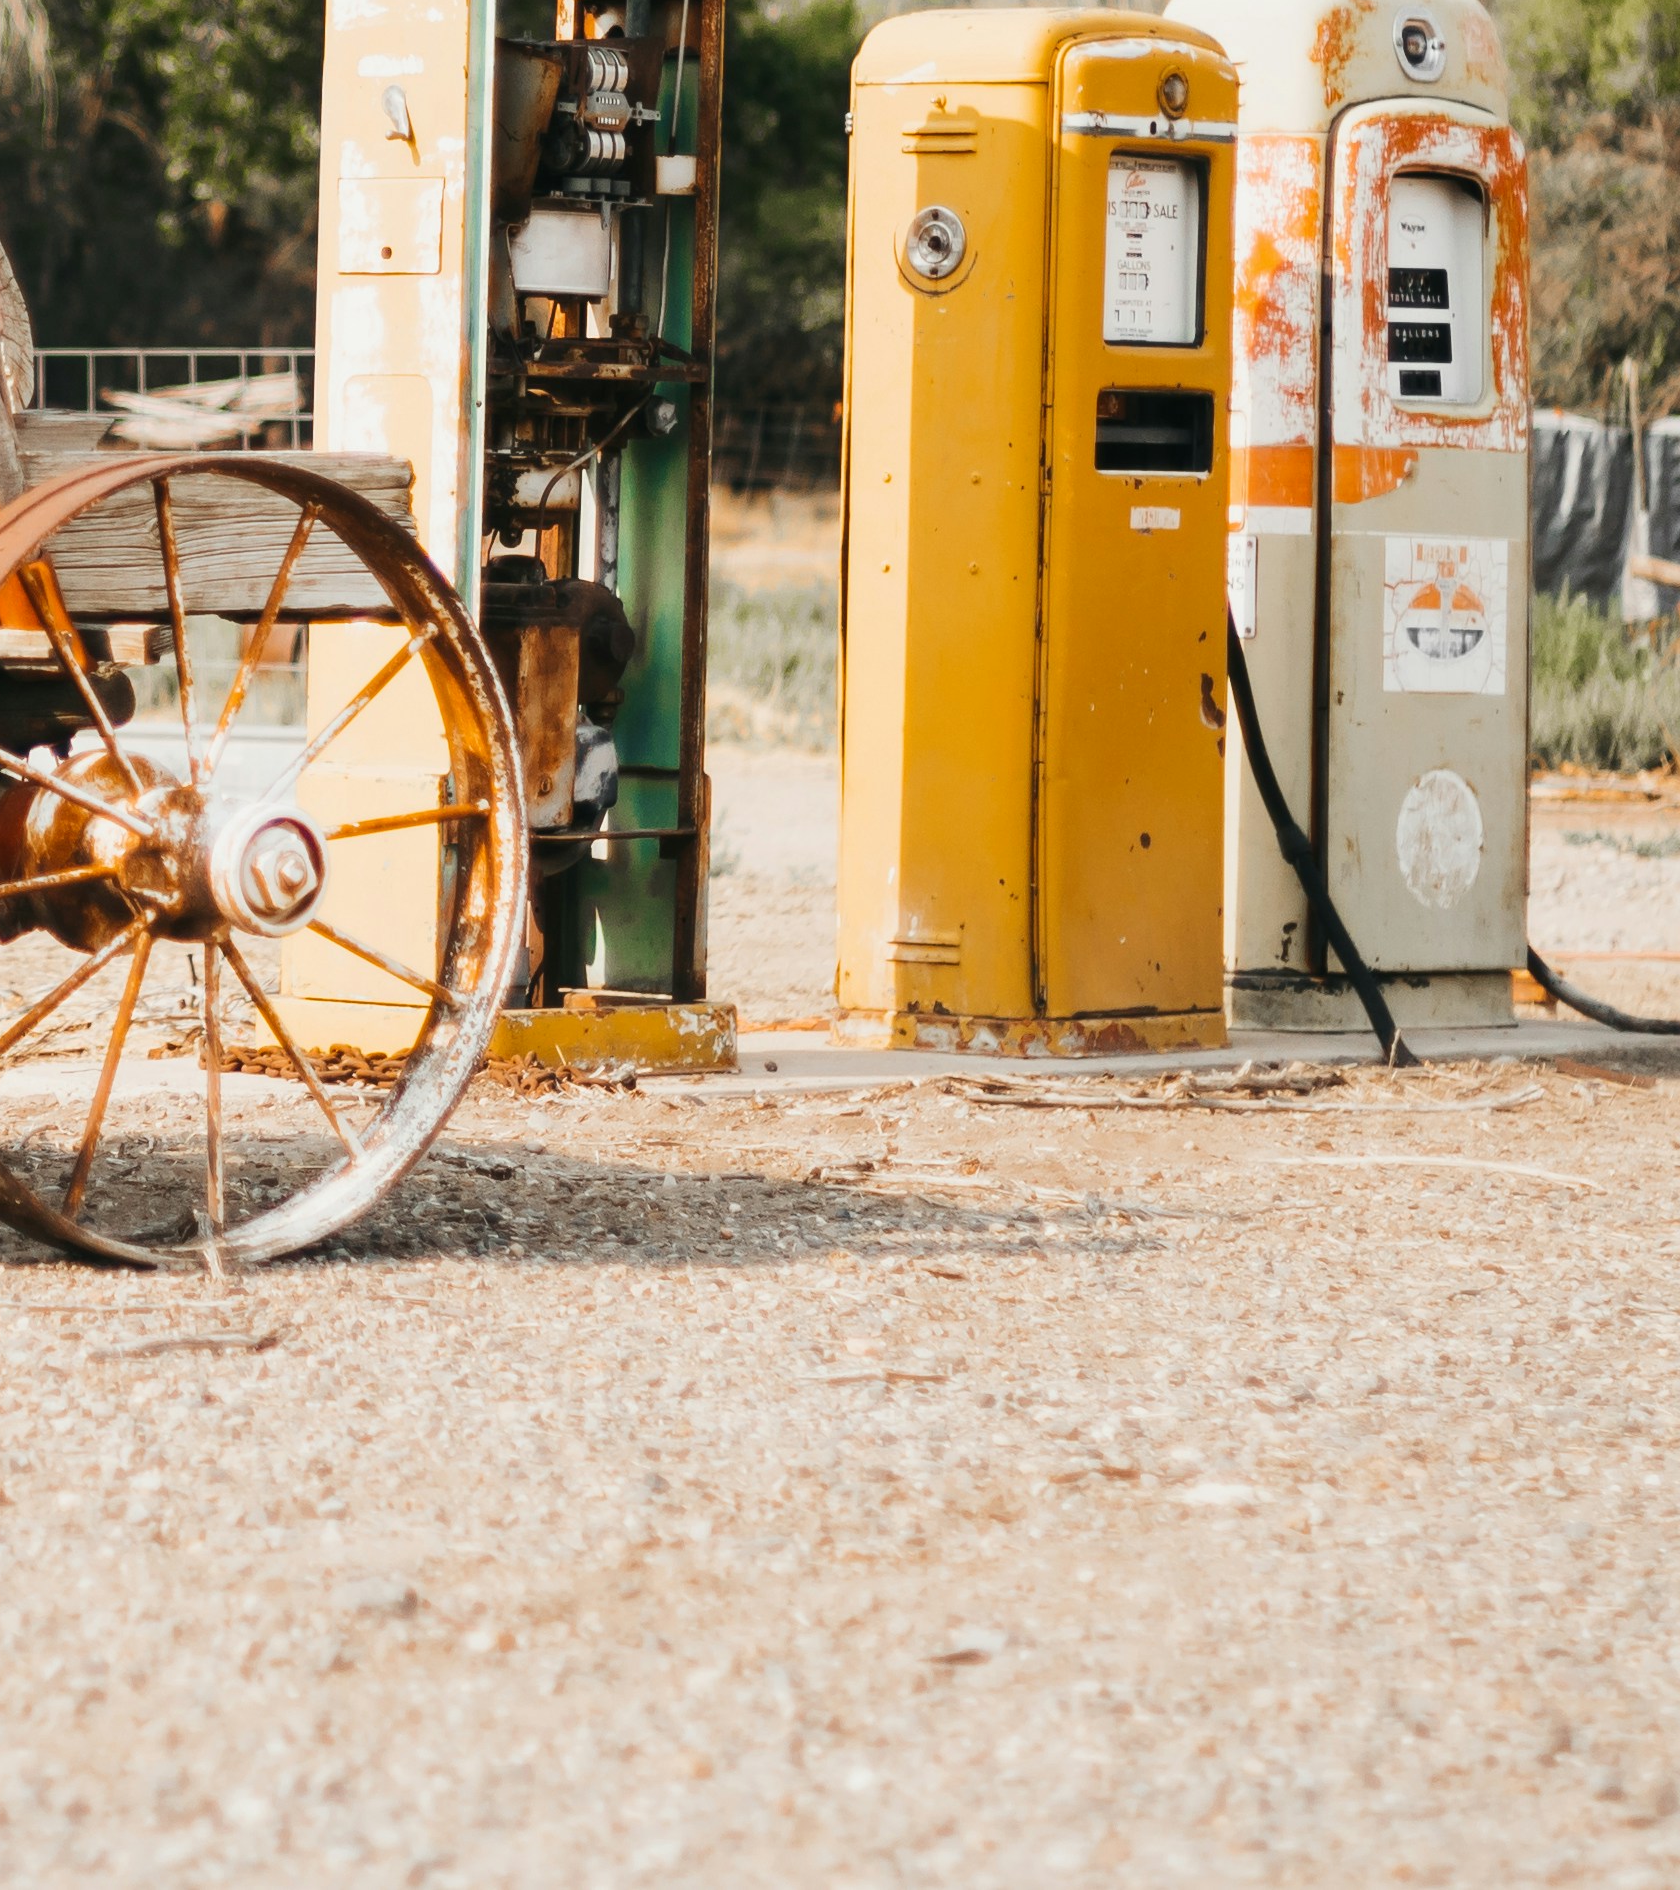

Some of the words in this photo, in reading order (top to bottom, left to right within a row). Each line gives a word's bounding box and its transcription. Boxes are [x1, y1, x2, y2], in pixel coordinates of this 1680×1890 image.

[1154, 204, 1178, 219] SALE
[1117, 260, 1151, 271] GALLONS
[1390, 293, 1415, 304] TOTAL
[1421, 294, 1441, 304] SALE
[1396, 329, 1439, 338] GALLONS
